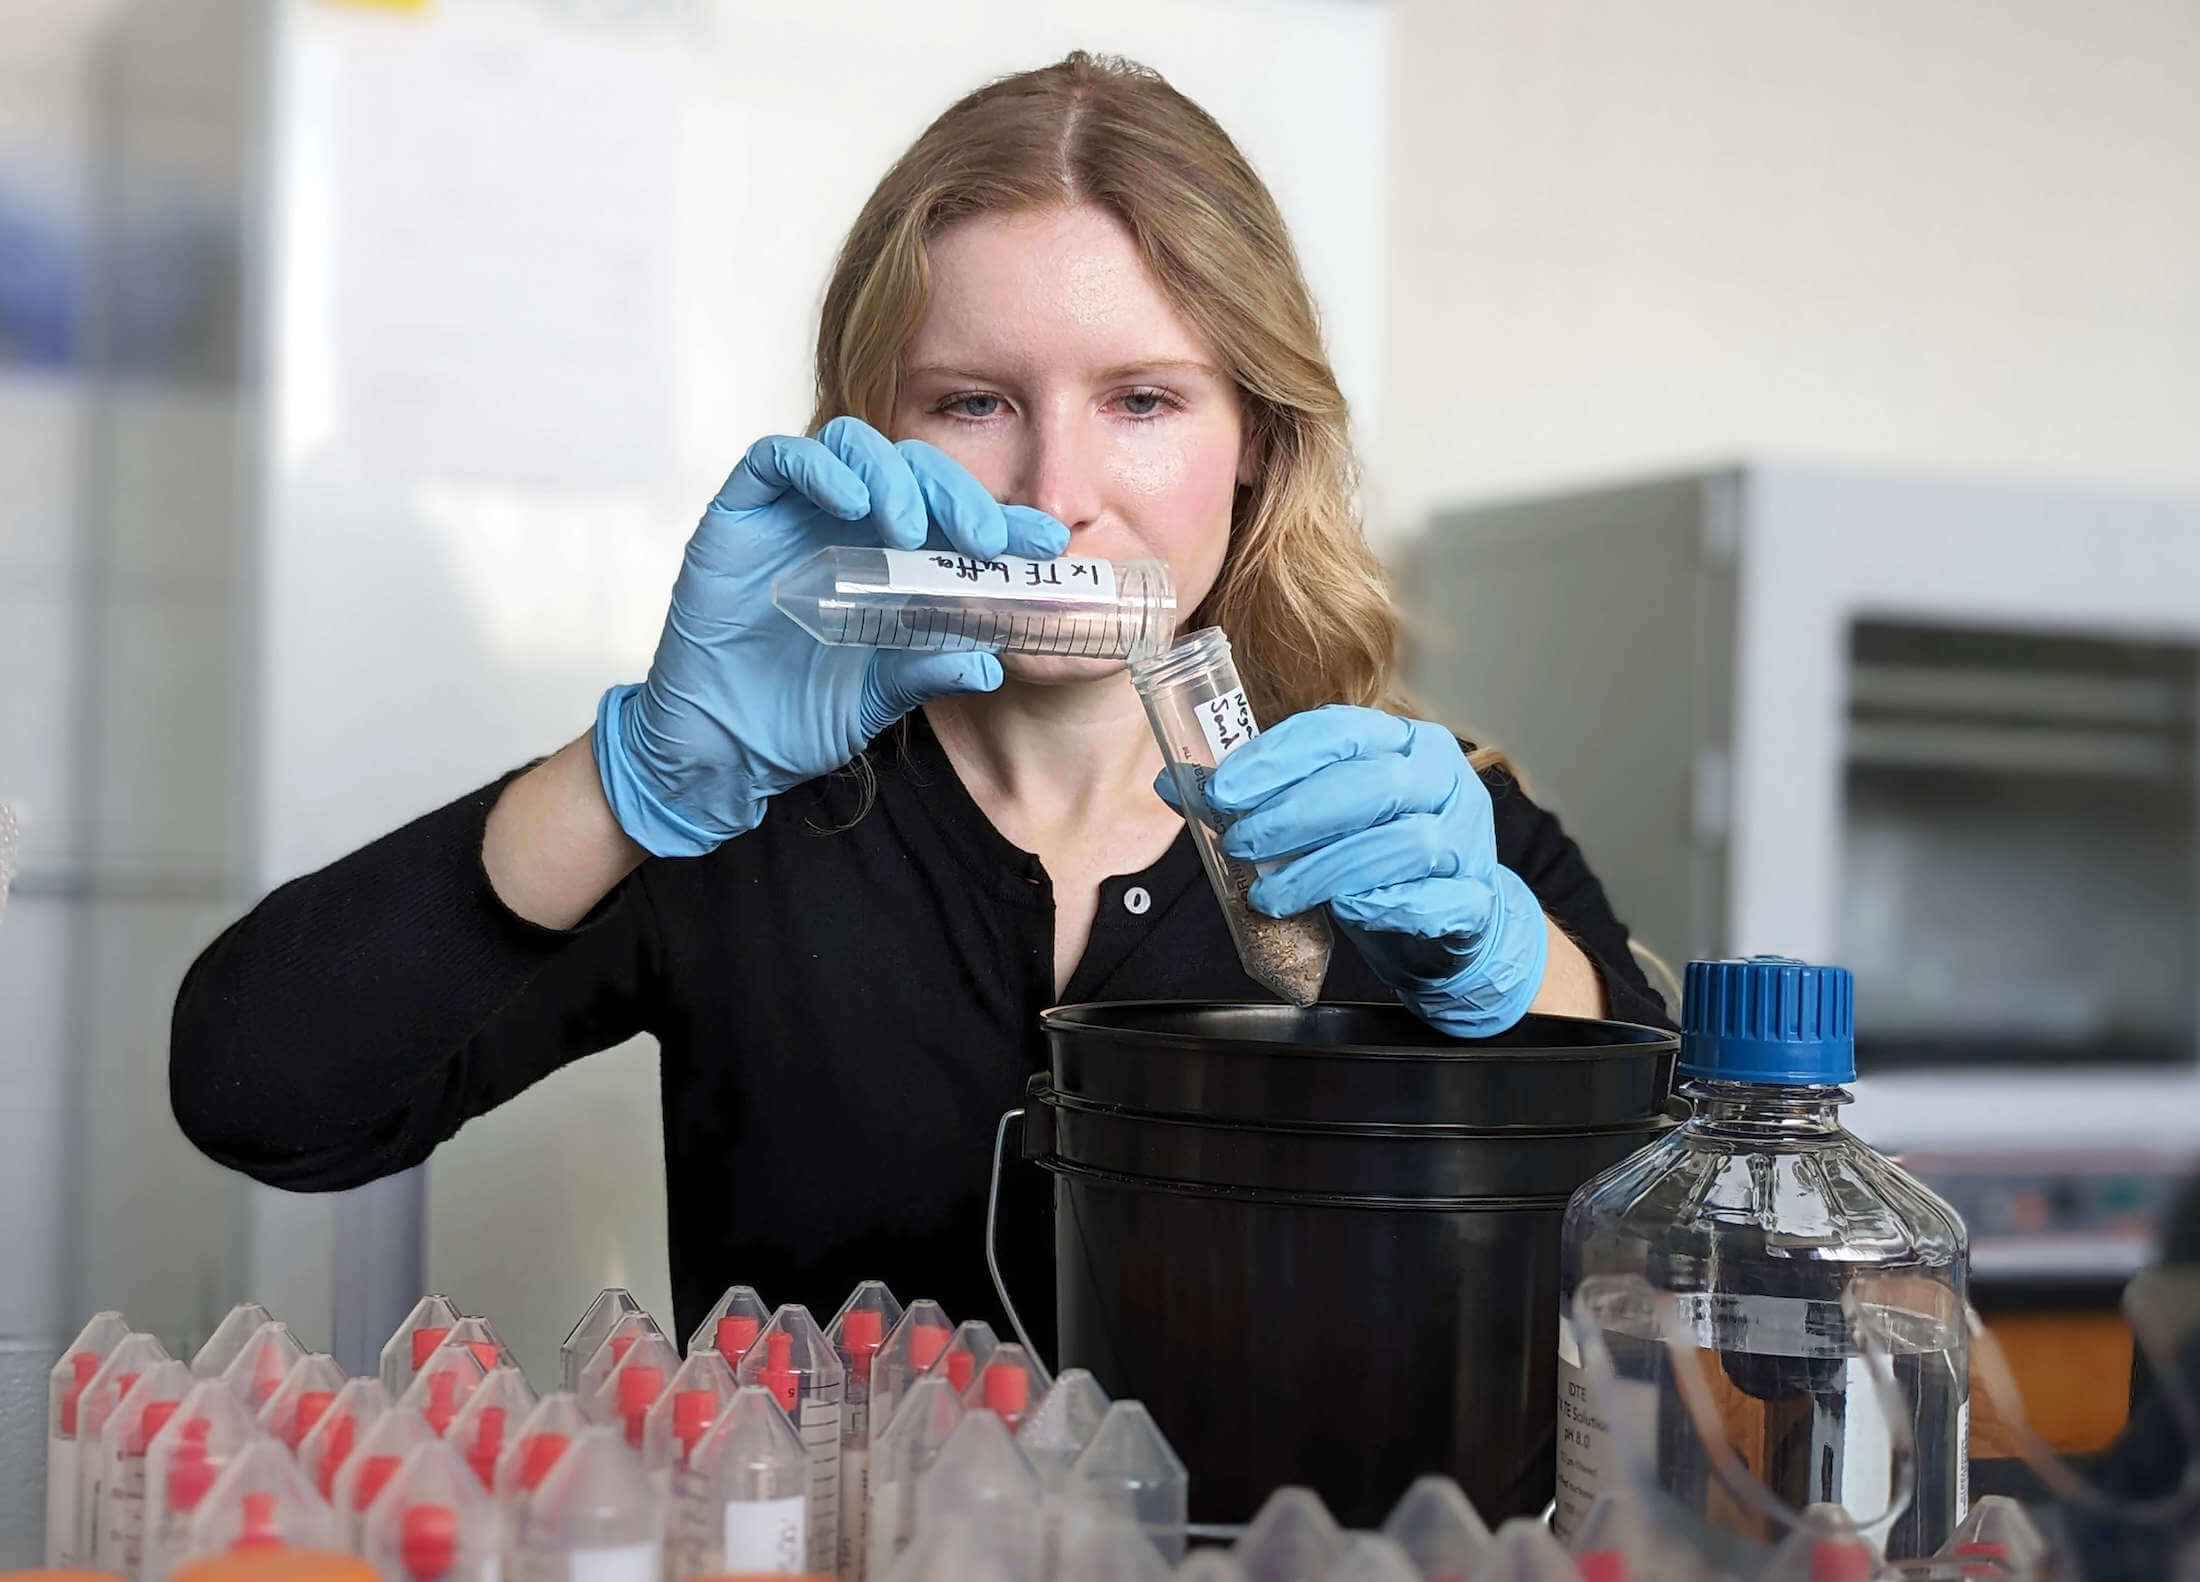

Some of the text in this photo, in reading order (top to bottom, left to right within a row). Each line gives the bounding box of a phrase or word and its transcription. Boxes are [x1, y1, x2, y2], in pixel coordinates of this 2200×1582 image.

[929, 556, 1010, 583] buffer
[1025, 563, 1062, 586] TE
[1211, 698, 1240, 750] Sand
[1234, 693, 1258, 741] Nega
[1576, 1431, 1591, 1449] 8.0
